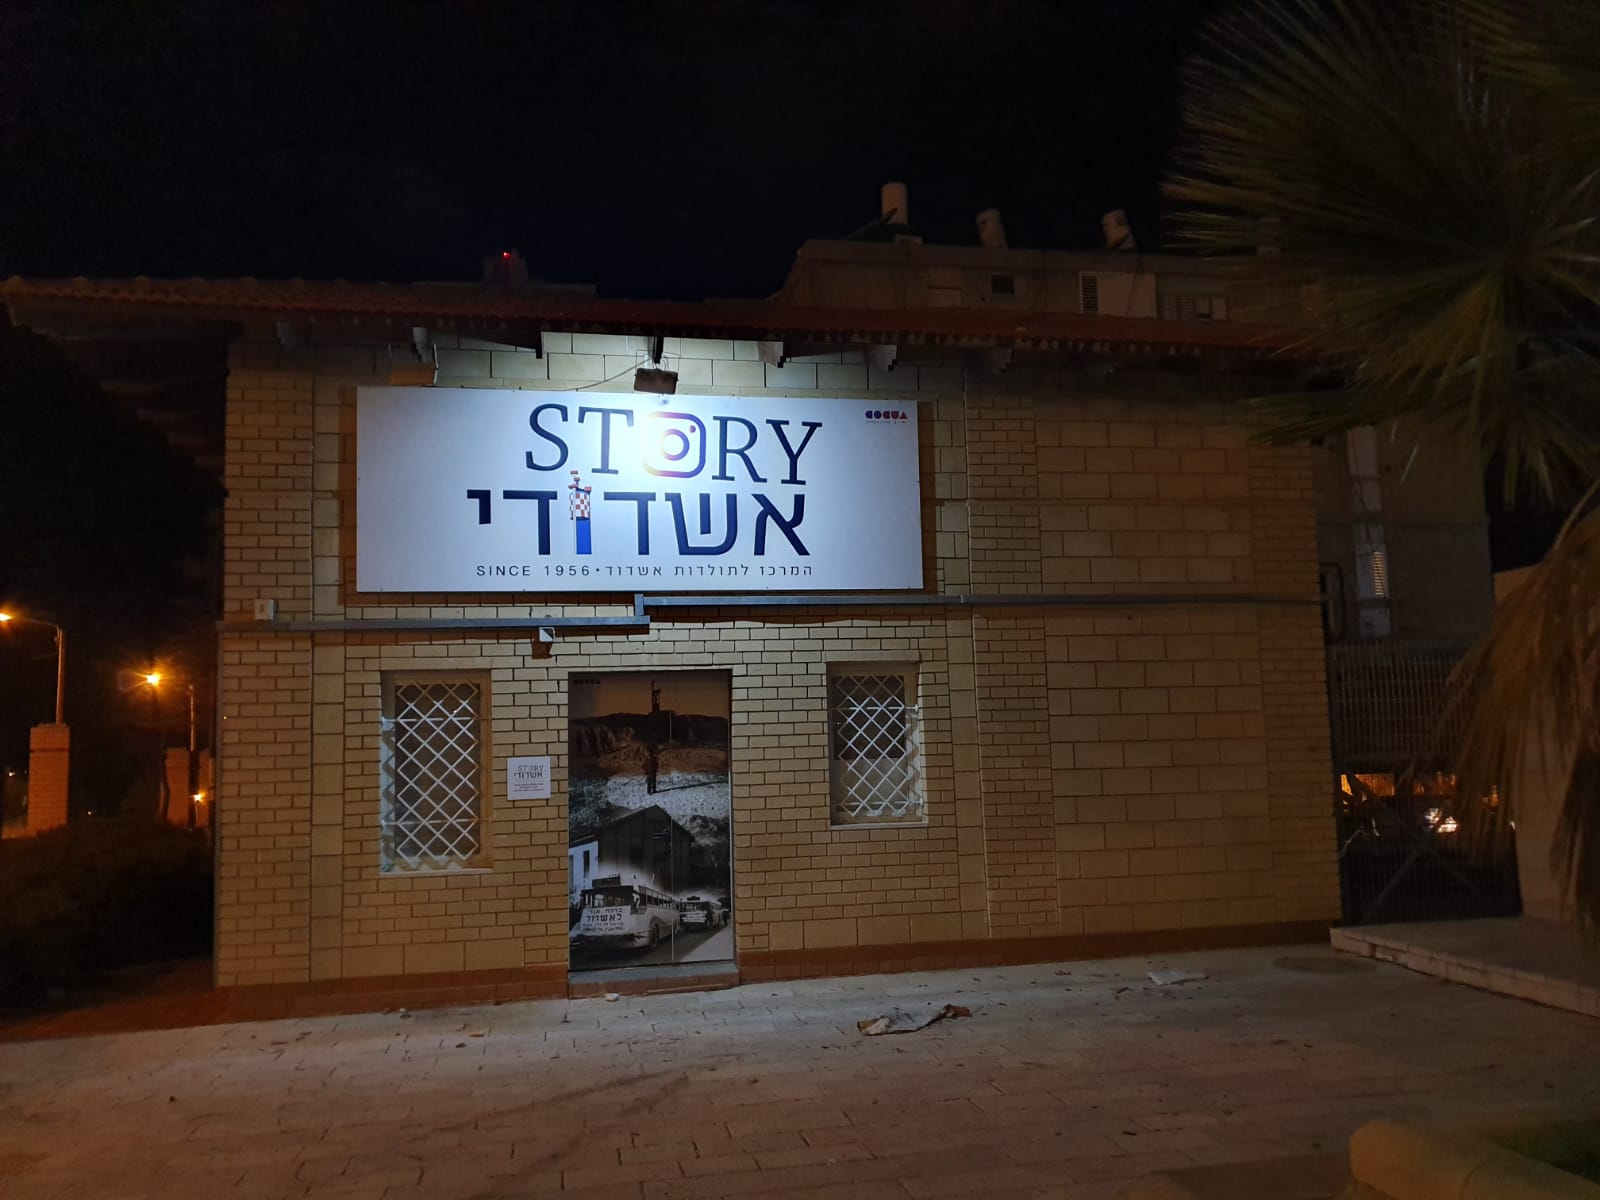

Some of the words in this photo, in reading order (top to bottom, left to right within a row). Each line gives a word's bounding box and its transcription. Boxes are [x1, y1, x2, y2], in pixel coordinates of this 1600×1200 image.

[525, 404, 822, 485] STORY
[466, 488, 810, 556] אשדודי
[476, 565, 532, 577] SINCE
[544, 565, 590, 577] 1956
[604, 565, 662, 577] אשדוד
[674, 564, 750, 577] לתולדות
[759, 564, 814, 577] המרכז
